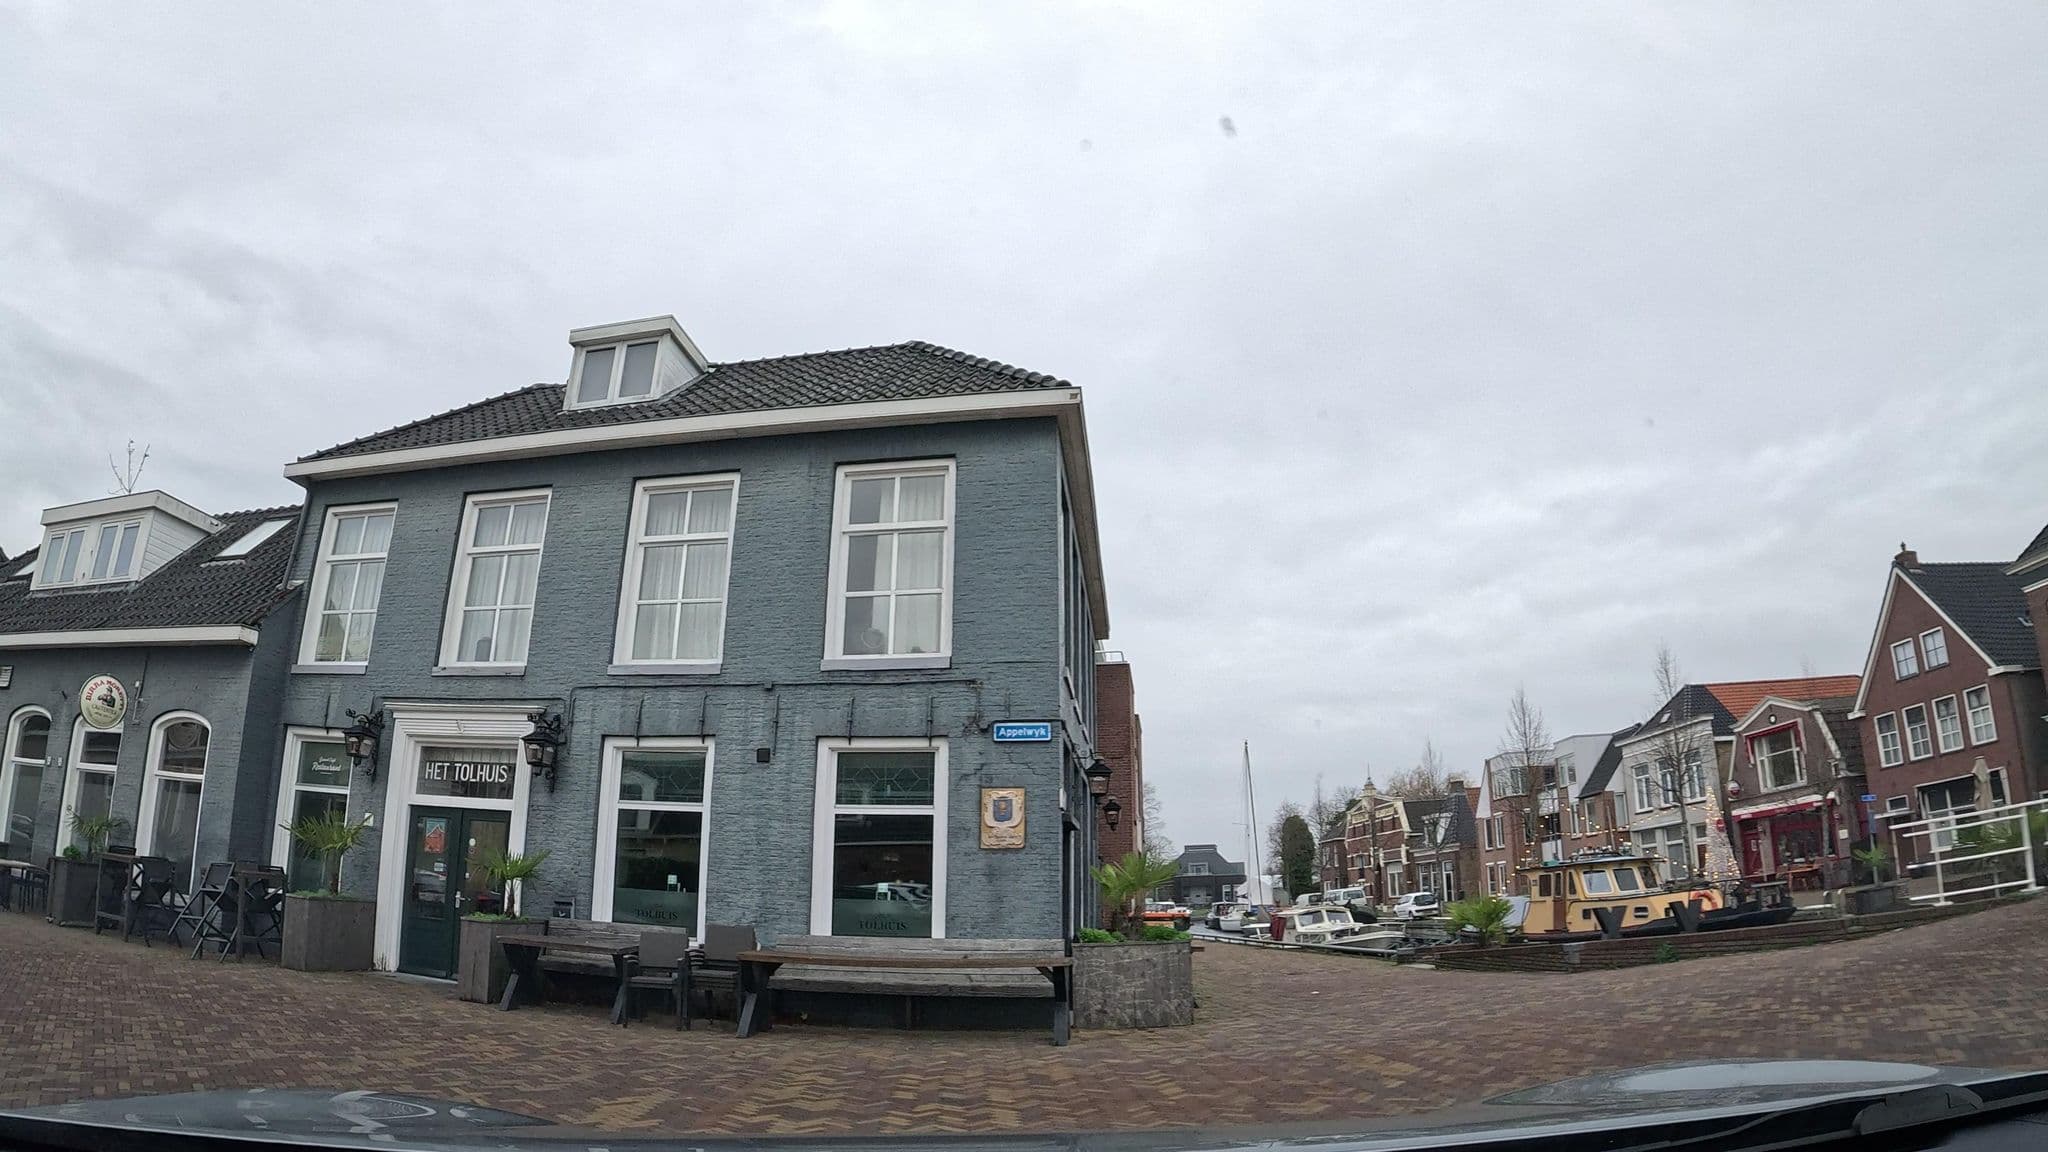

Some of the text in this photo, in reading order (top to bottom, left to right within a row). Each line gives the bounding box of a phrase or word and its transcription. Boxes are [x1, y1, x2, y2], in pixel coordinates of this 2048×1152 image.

[998, 727, 1047, 738] Appelwyk
[425, 762, 508, 783] HET TOLHUIS
[635, 908, 679, 920] TOLHUIS
[858, 920, 908, 931] TOLHUIS
